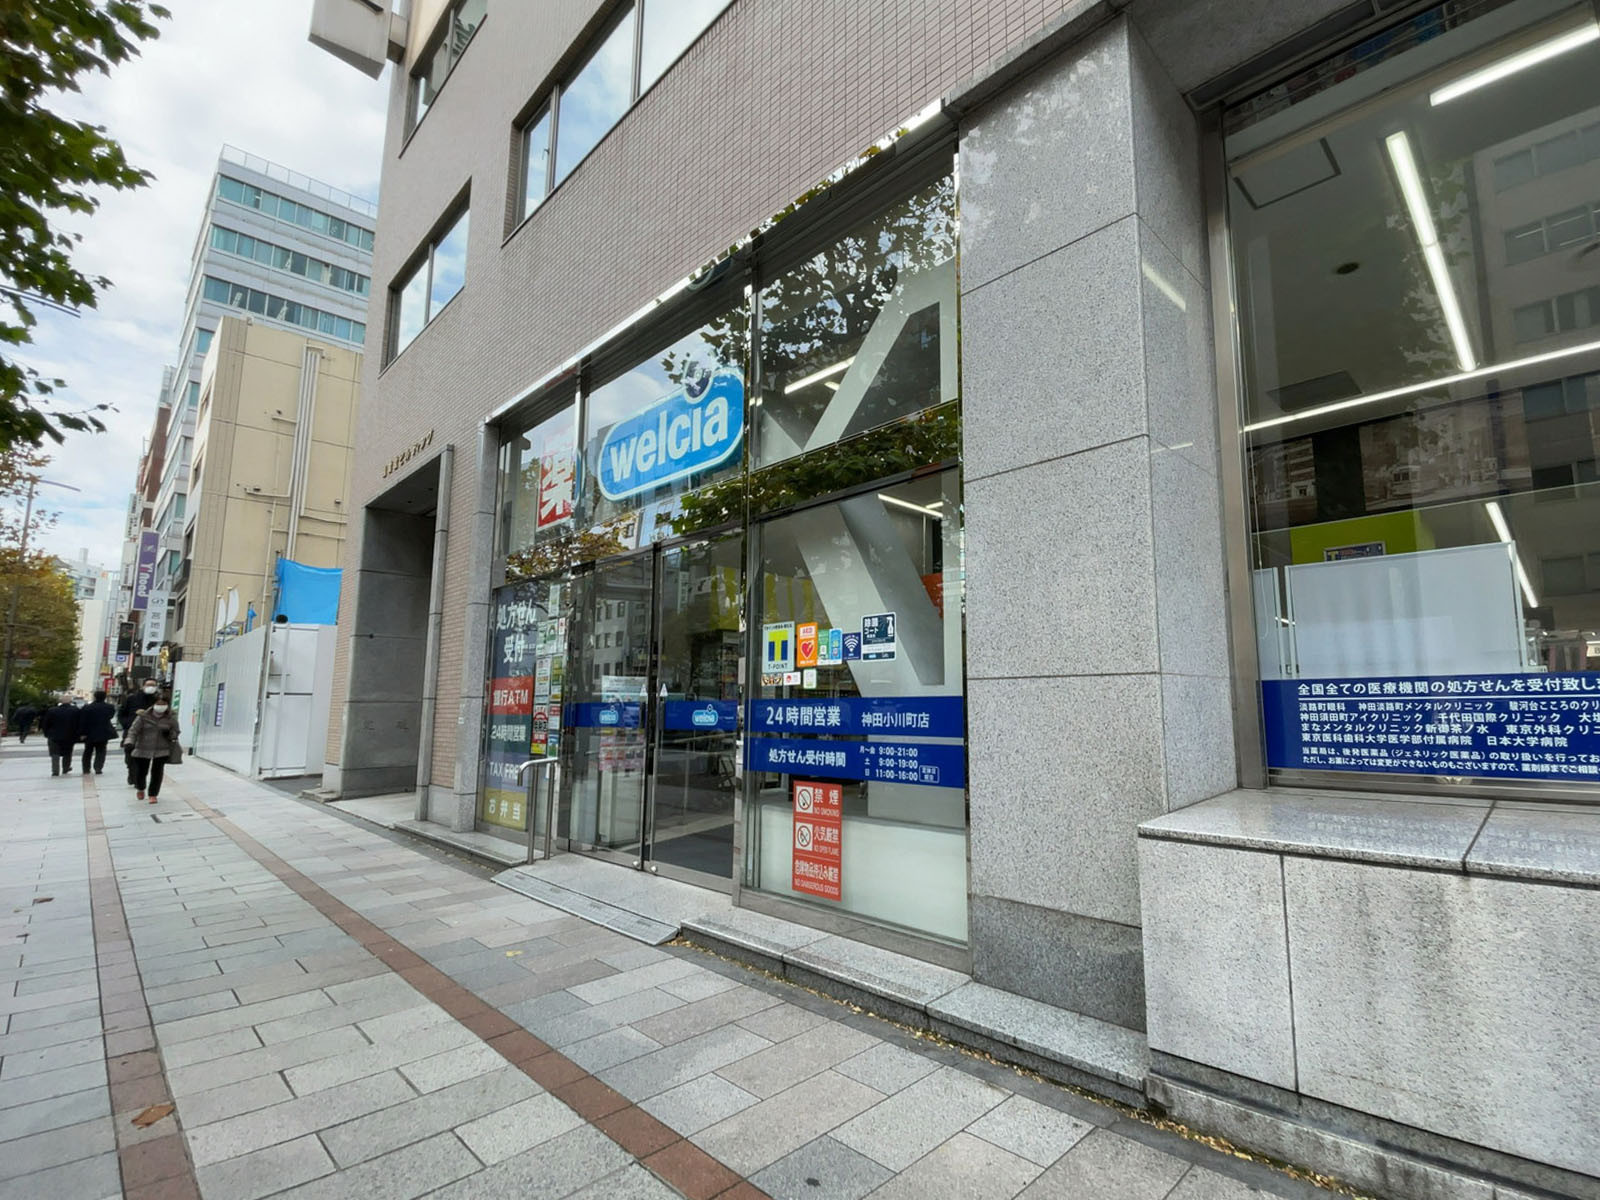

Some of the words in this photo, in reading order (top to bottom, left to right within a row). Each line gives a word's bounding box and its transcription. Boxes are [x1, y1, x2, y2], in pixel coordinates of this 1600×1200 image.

[610, 397, 729, 482] welcia
[504, 633, 525, 663] 受付
[766, 706, 841, 727] 24時間営業
[861, 712, 930, 728] 神田小川町店
[1486, 736, 1569, 747] 日本大学病院
[769, 749, 846, 767] 処方せん受付時間
[490, 762, 502, 776] TAX
